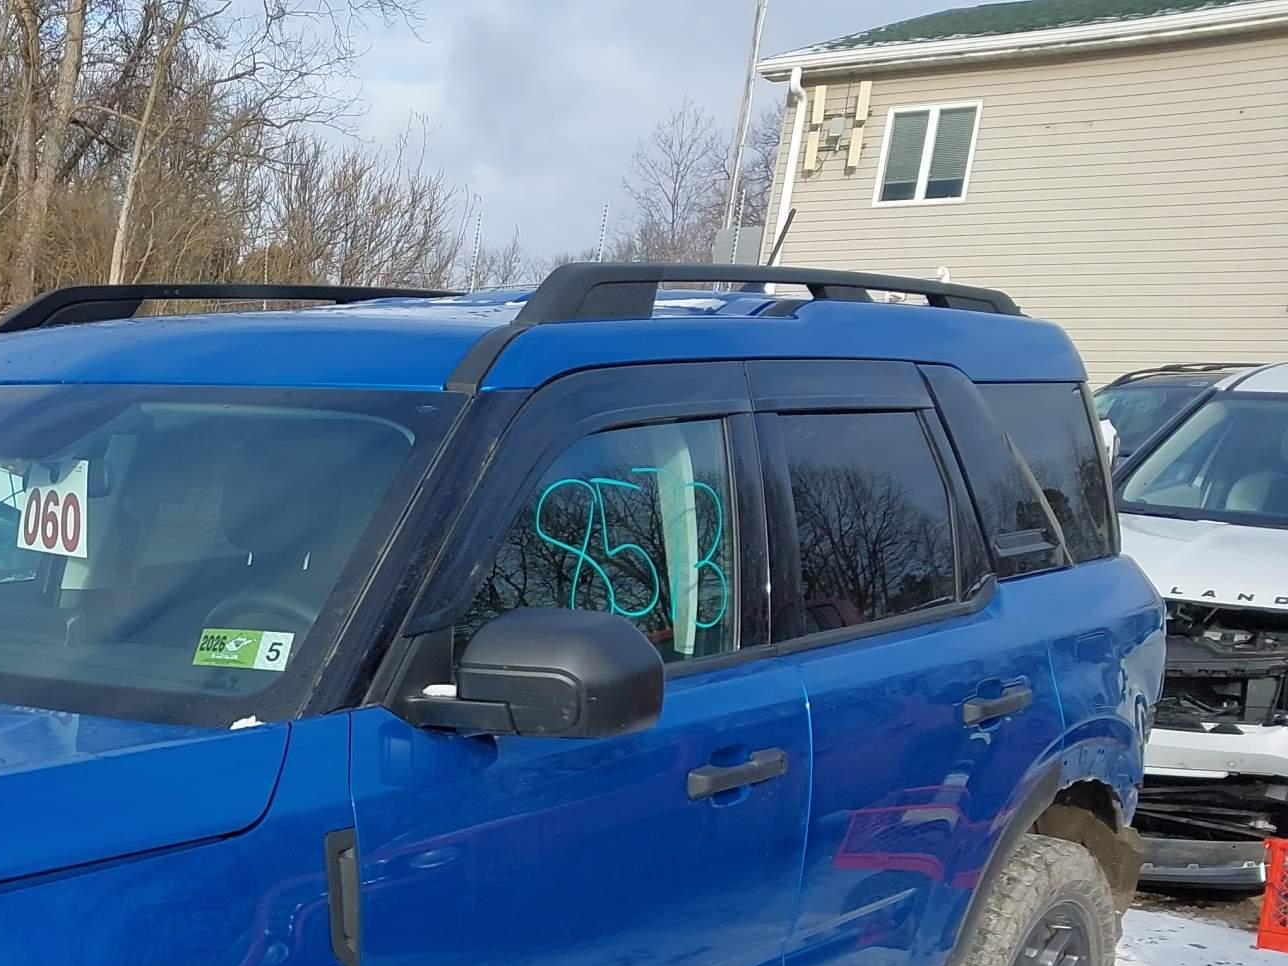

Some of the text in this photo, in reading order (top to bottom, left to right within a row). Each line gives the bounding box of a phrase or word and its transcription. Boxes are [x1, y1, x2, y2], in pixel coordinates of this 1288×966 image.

[23, 487, 81, 553] 060
[199, 634, 284, 662] 2026 5
